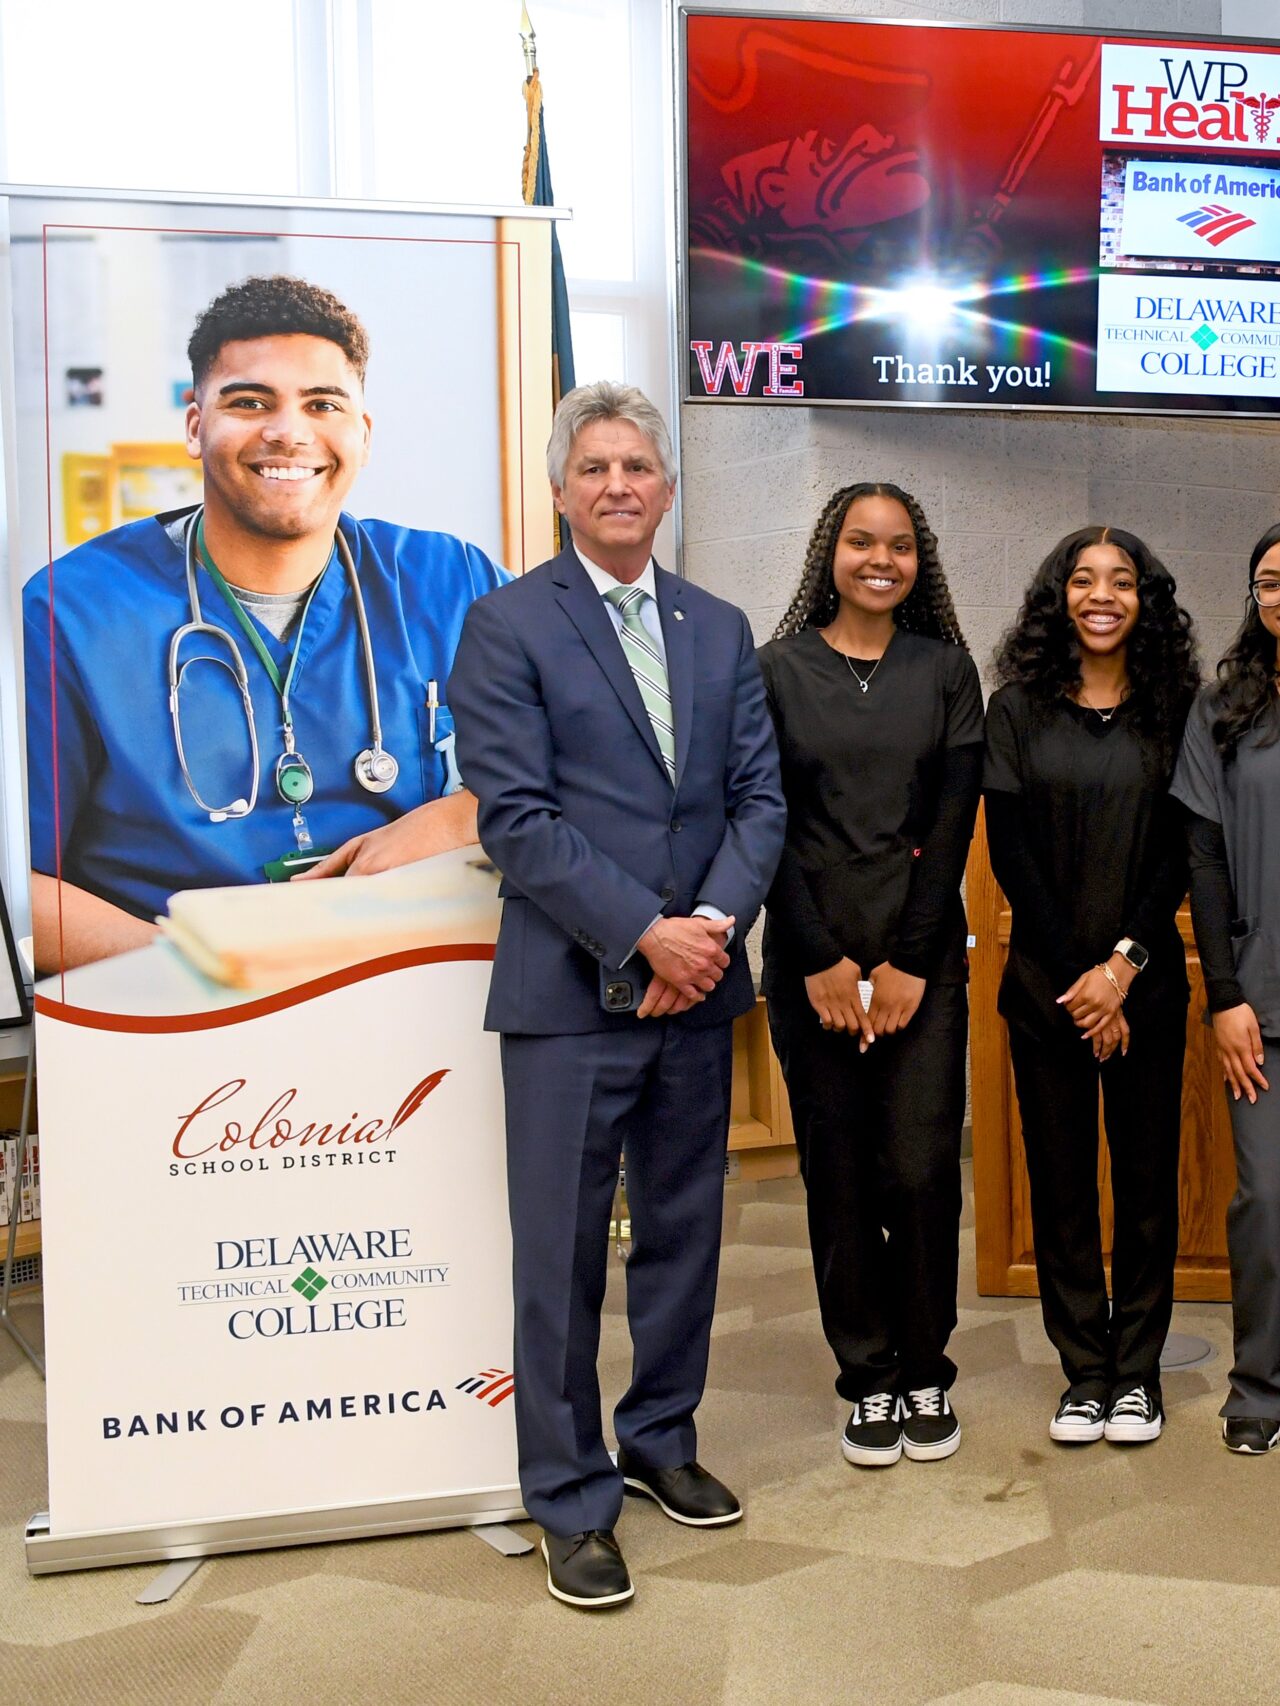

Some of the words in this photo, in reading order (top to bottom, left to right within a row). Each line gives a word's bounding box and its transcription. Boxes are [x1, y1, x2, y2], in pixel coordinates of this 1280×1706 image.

[1160, 58, 1248, 102] WP
[1133, 171, 1187, 193] Bank
[1190, 174, 1212, 194] of
[1104, 328, 1188, 343] TECHNICAL
[690, 341, 804, 397] WE
[770, 344, 779, 394] Community
[872, 355, 978, 386] Thank
[986, 361, 1051, 393] you!
[1140, 351, 1277, 379] COLLEGE
[171, 1068, 452, 1158] Colonial
[169, 1158, 270, 1176] SCHOOL
[283, 1150, 398, 1169] DISTRICT
[215, 1229, 413, 1270] DELAWARE
[178, 1279, 289, 1301] TECHNICAL
[330, 1267, 449, 1290] COMMUNITY
[228, 1299, 407, 1340] COLLEGE
[102, 1409, 207, 1440] BANK
[221, 1404, 265, 1429] OF
[278, 1389, 447, 1425] AMERICA
